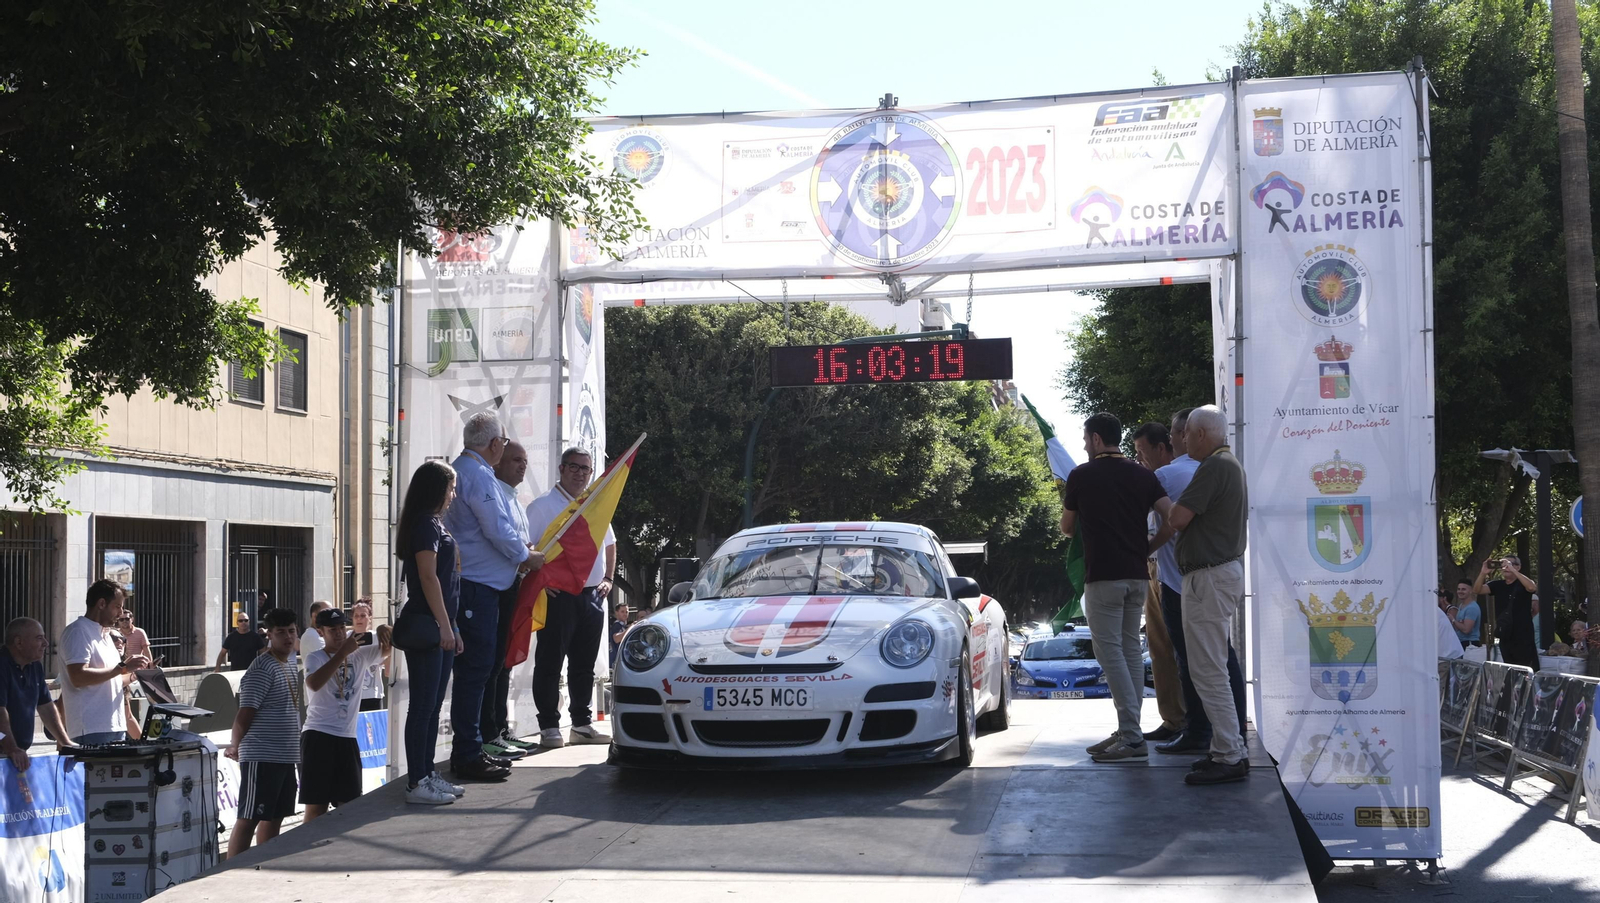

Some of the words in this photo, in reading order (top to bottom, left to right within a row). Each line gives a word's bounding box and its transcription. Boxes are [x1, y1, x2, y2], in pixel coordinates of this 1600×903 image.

[833, 133, 843, 142] 48
[843, 119, 867, 134] RALLYE
[1091, 124, 1149, 137] Federación
[1150, 120, 1198, 131] andaluza
[1293, 116, 1402, 136] DIPUTACIÓN
[654, 134, 671, 152] CLUB
[1087, 137, 1102, 145] de
[1105, 130, 1197, 144] automovilismo
[1294, 138, 1317, 153] DE
[1321, 132, 1399, 152] ALMERÍA
[1091, 146, 1153, 162] Andalucía
[853, 157, 898, 184] AUTOMOVIL
[902, 162, 920, 184] CLUB
[1174, 160, 1200, 168] Andalucía
[966, 144, 1046, 216] 2023
[1311, 190, 1372, 207] COSTA
[1377, 189, 1401, 203] DE
[1131, 202, 1194, 220] COSTA
[1200, 200, 1225, 216] DE
[1292, 204, 1404, 234] ALMERÍA
[1111, 217, 1228, 248] ALMERÍA
[634, 241, 708, 259] ALMERÍA
[844, 246, 851, 255] de
[851, 252, 886, 266] septiembre
[901, 250, 926, 262] octubre
[925, 239, 939, 252] 2023
[436, 268, 484, 277] DEPORTES
[486, 268, 500, 276] DE
[1296, 251, 1344, 281] AUTOMOVIL
[1348, 257, 1367, 279] CLUB
[1311, 313, 1355, 325] ALMERIA
[492, 329, 524, 338] ALMERÍA
[813, 343, 964, 384] 16:03:19
[1273, 404, 1349, 421] Ayuntamiento
[1352, 403, 1366, 414] de
[1369, 402, 1400, 414] Vícar
[1282, 424, 1325, 440] Corazón
[1327, 421, 1343, 433] del
[1345, 418, 1391, 432] Poniente
[746, 534, 900, 548] PORSCHE
[1292, 579, 1339, 587] Ayuntamiento
[674, 675, 779, 684] AUTODESGUACES
[785, 673, 854, 682] SEVILLA
[716, 688, 764, 707] 5345
[771, 688, 808, 707] MCG
[1286, 709, 1332, 717] Ayuntamiento
[1301, 734, 1395, 789] Enix
[1382, 776, 1390, 784] TI
[1358, 810, 1426, 820] DRAGO
